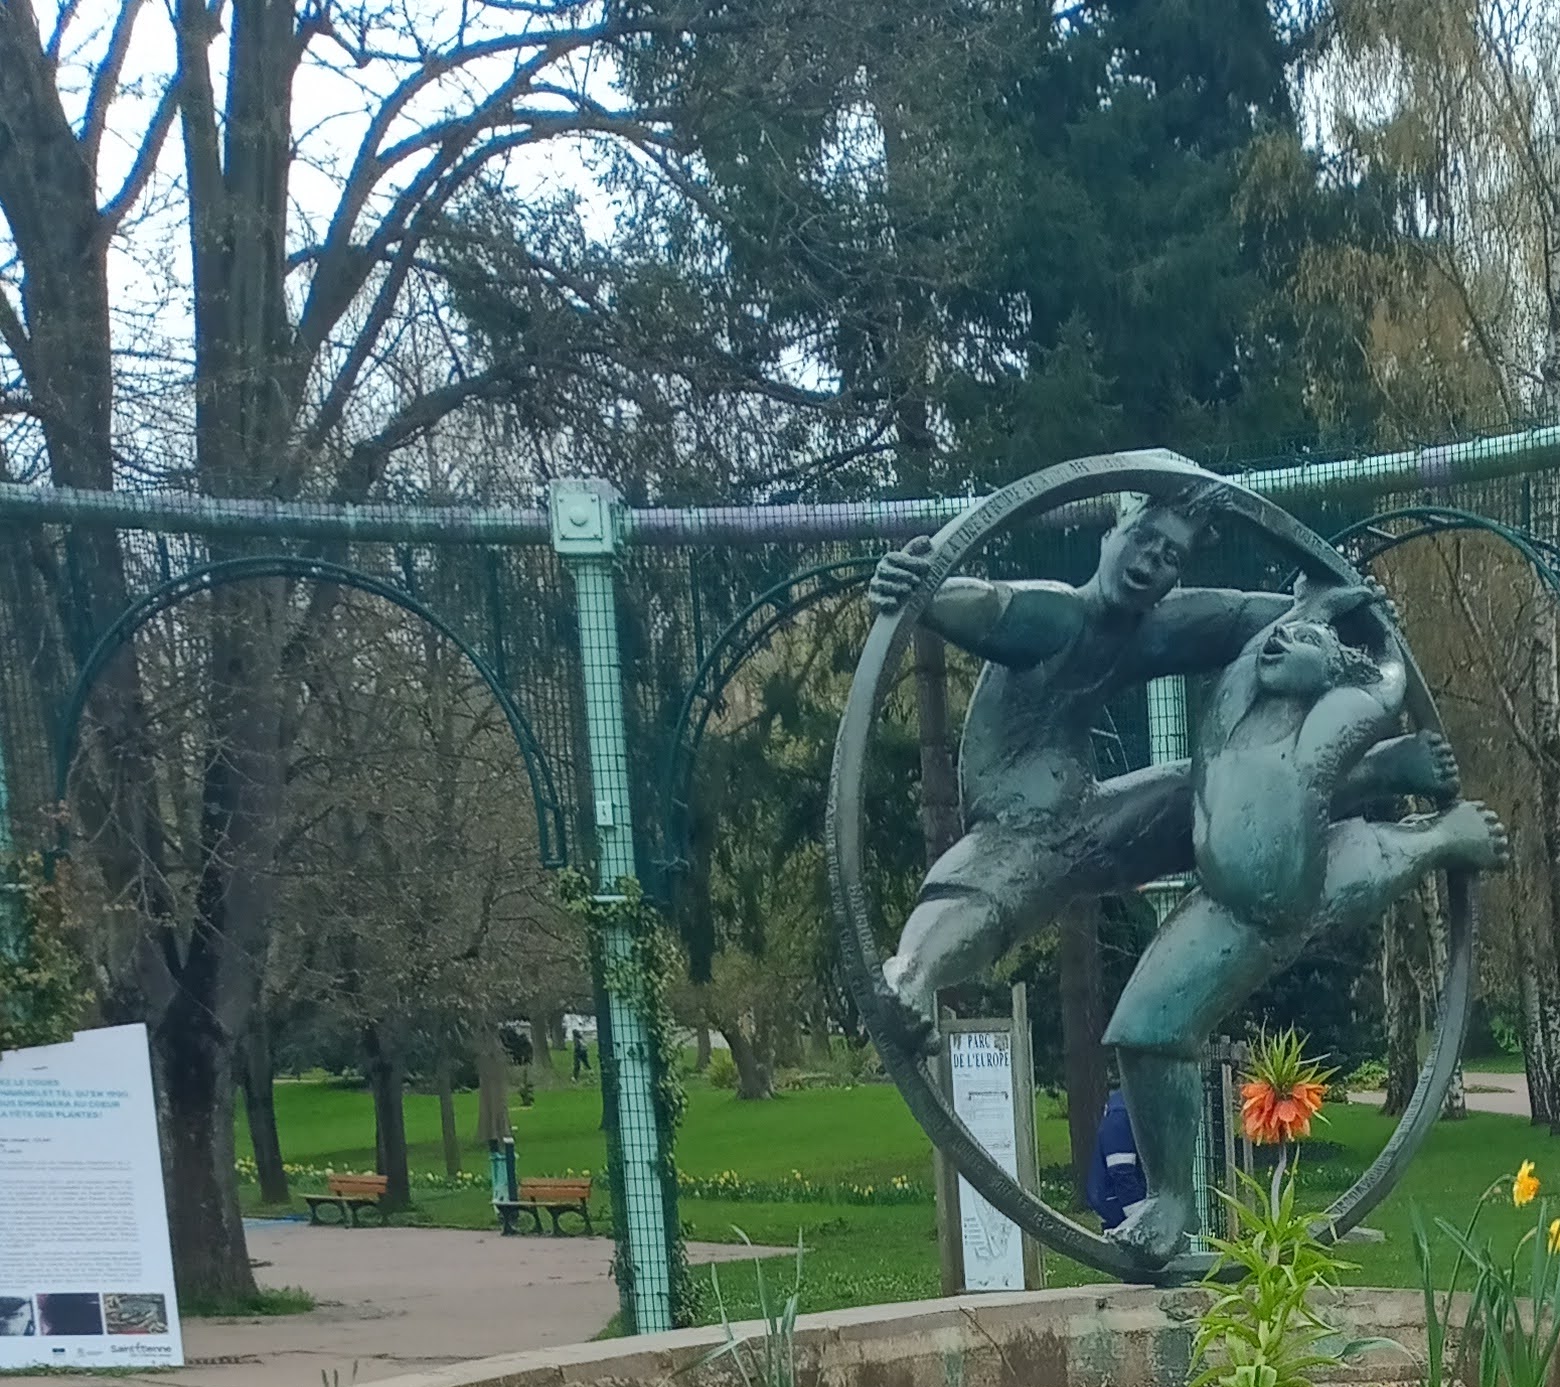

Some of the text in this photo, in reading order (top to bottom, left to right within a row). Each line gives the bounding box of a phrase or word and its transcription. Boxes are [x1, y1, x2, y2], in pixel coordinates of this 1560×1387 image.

[968, 1033, 991, 1049] PARC
[953, 1051, 1010, 1069] DE L'EUROPE
[55, 1089, 73, 1097] TEL
[35, 1110, 54, 1119] DES
